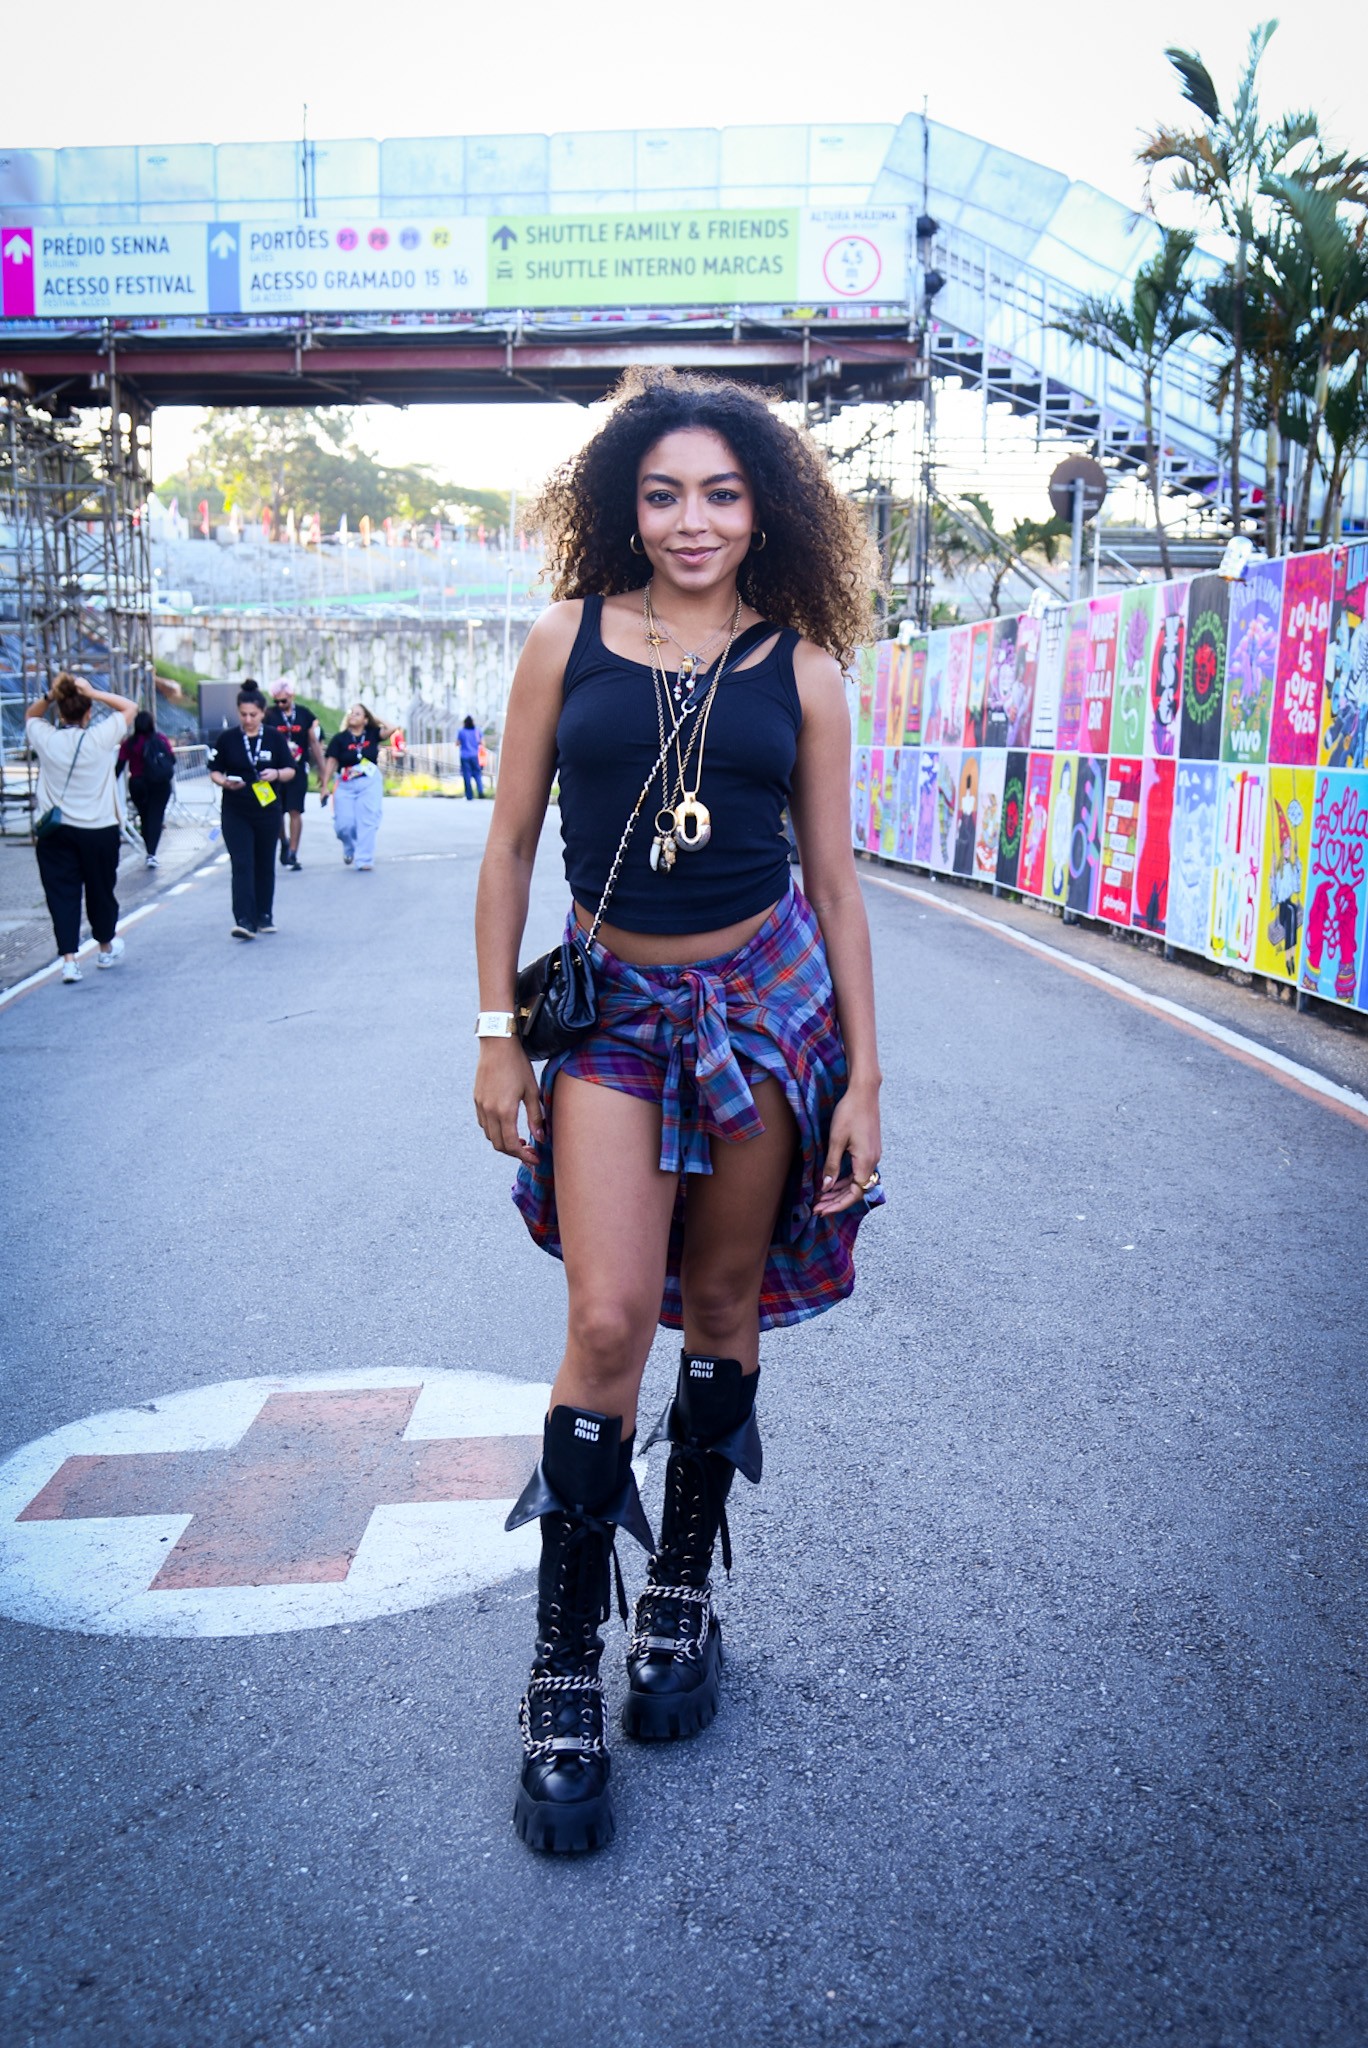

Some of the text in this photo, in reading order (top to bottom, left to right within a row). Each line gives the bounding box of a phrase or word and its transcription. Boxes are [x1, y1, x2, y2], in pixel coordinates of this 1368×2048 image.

[43, 233, 170, 256] PRÉDIO SENNA
[250, 225, 329, 250] PORTÕES
[526, 219, 789, 244] SHUTTLE FAMILY & FRIENDS
[250, 269, 468, 291] ACESSO GRAMADO 15 16
[526, 255, 784, 279] SHUTTLE INTERNO MARCAS
[43, 274, 195, 296] ACESSO FESTIVAL
[1287, 595, 1328, 642] LOLLA
[1283, 671, 1317, 710] LOVE
[1087, 701, 1104, 730] BR
[1288, 700, 1316, 734] 2026
[1230, 720, 1261, 752] vivo
[1315, 777, 1368, 839] Lolla
[1311, 824, 1364, 878] Love
